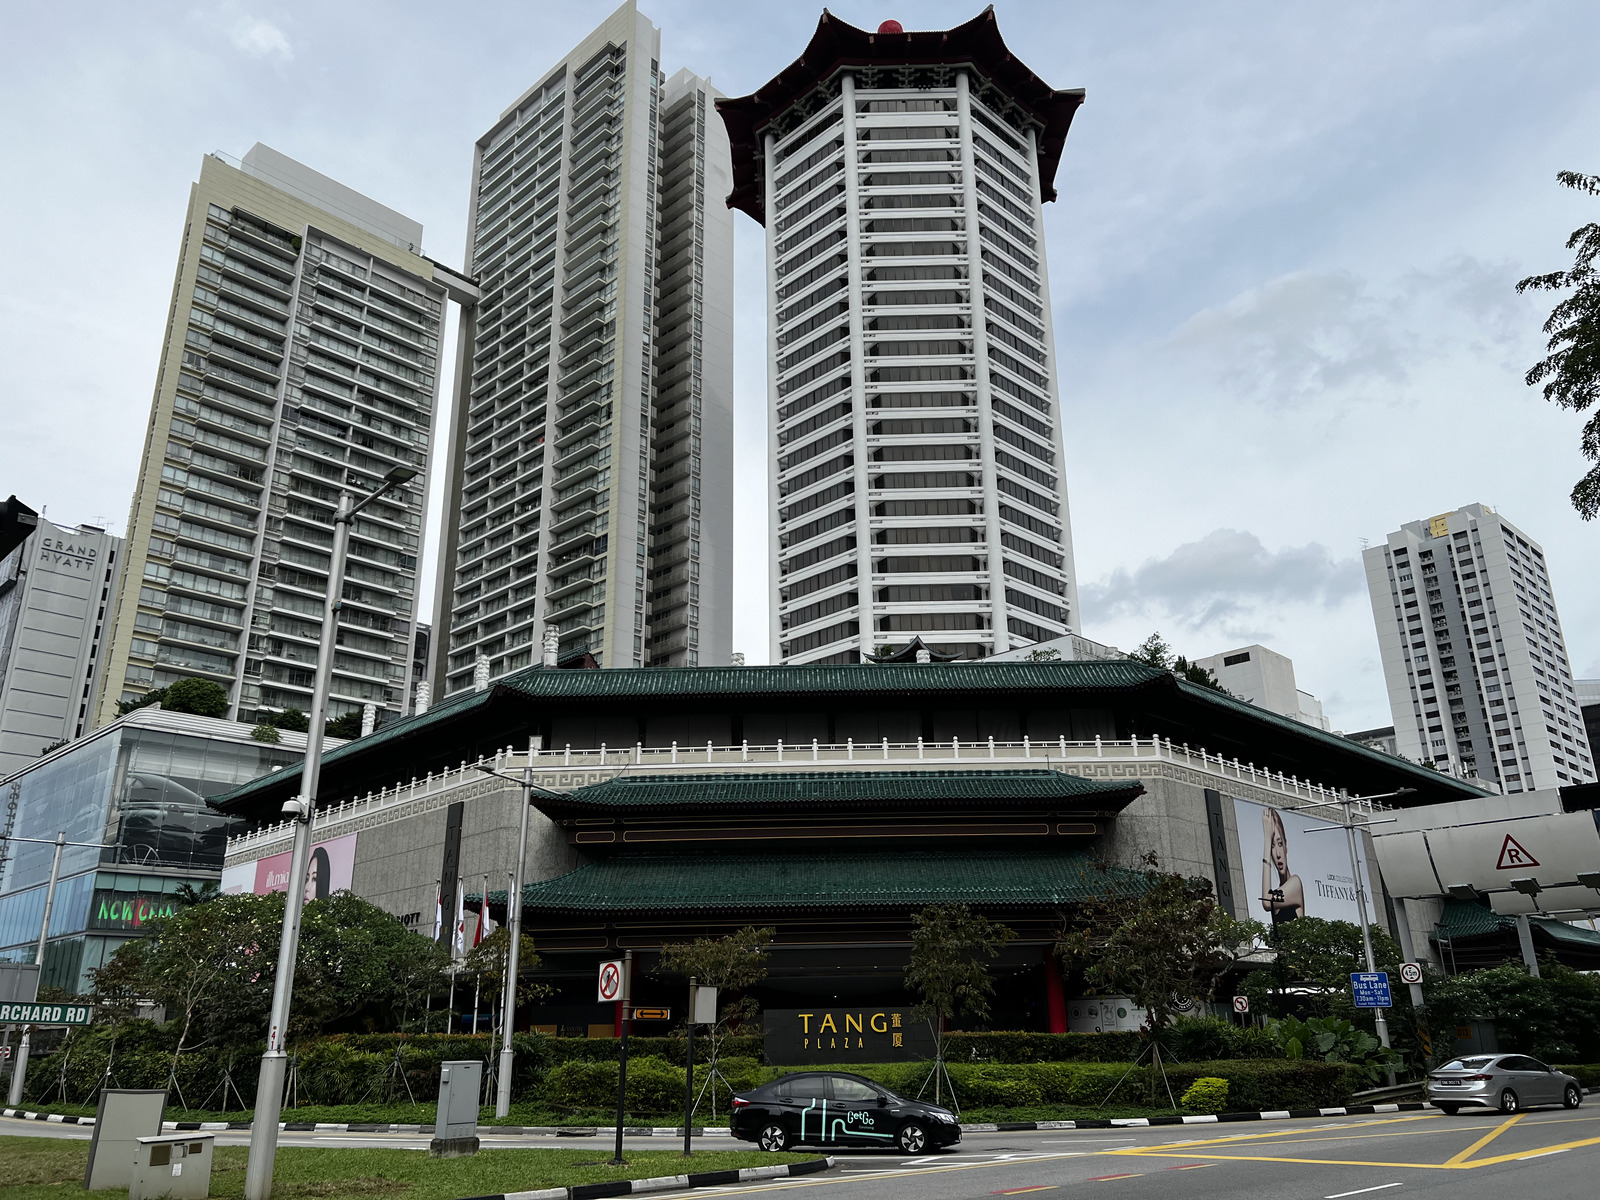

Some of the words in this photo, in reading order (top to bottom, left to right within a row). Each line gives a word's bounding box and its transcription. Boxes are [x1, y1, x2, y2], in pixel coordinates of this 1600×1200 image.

[43, 538, 97, 558] GRAND
[41, 552, 93, 571] HYATT
[1213, 813, 1230, 898] TANG
[1507, 848, 1523, 863] R
[1353, 981, 1368, 989] Bus
[1369, 981, 1387, 989] Lane
[66, 1007, 86, 1022] RD
[798, 1013, 887, 1034] TANG
[804, 1037, 863, 1049] PLAZA
[847, 1110, 875, 1125] GetGo
